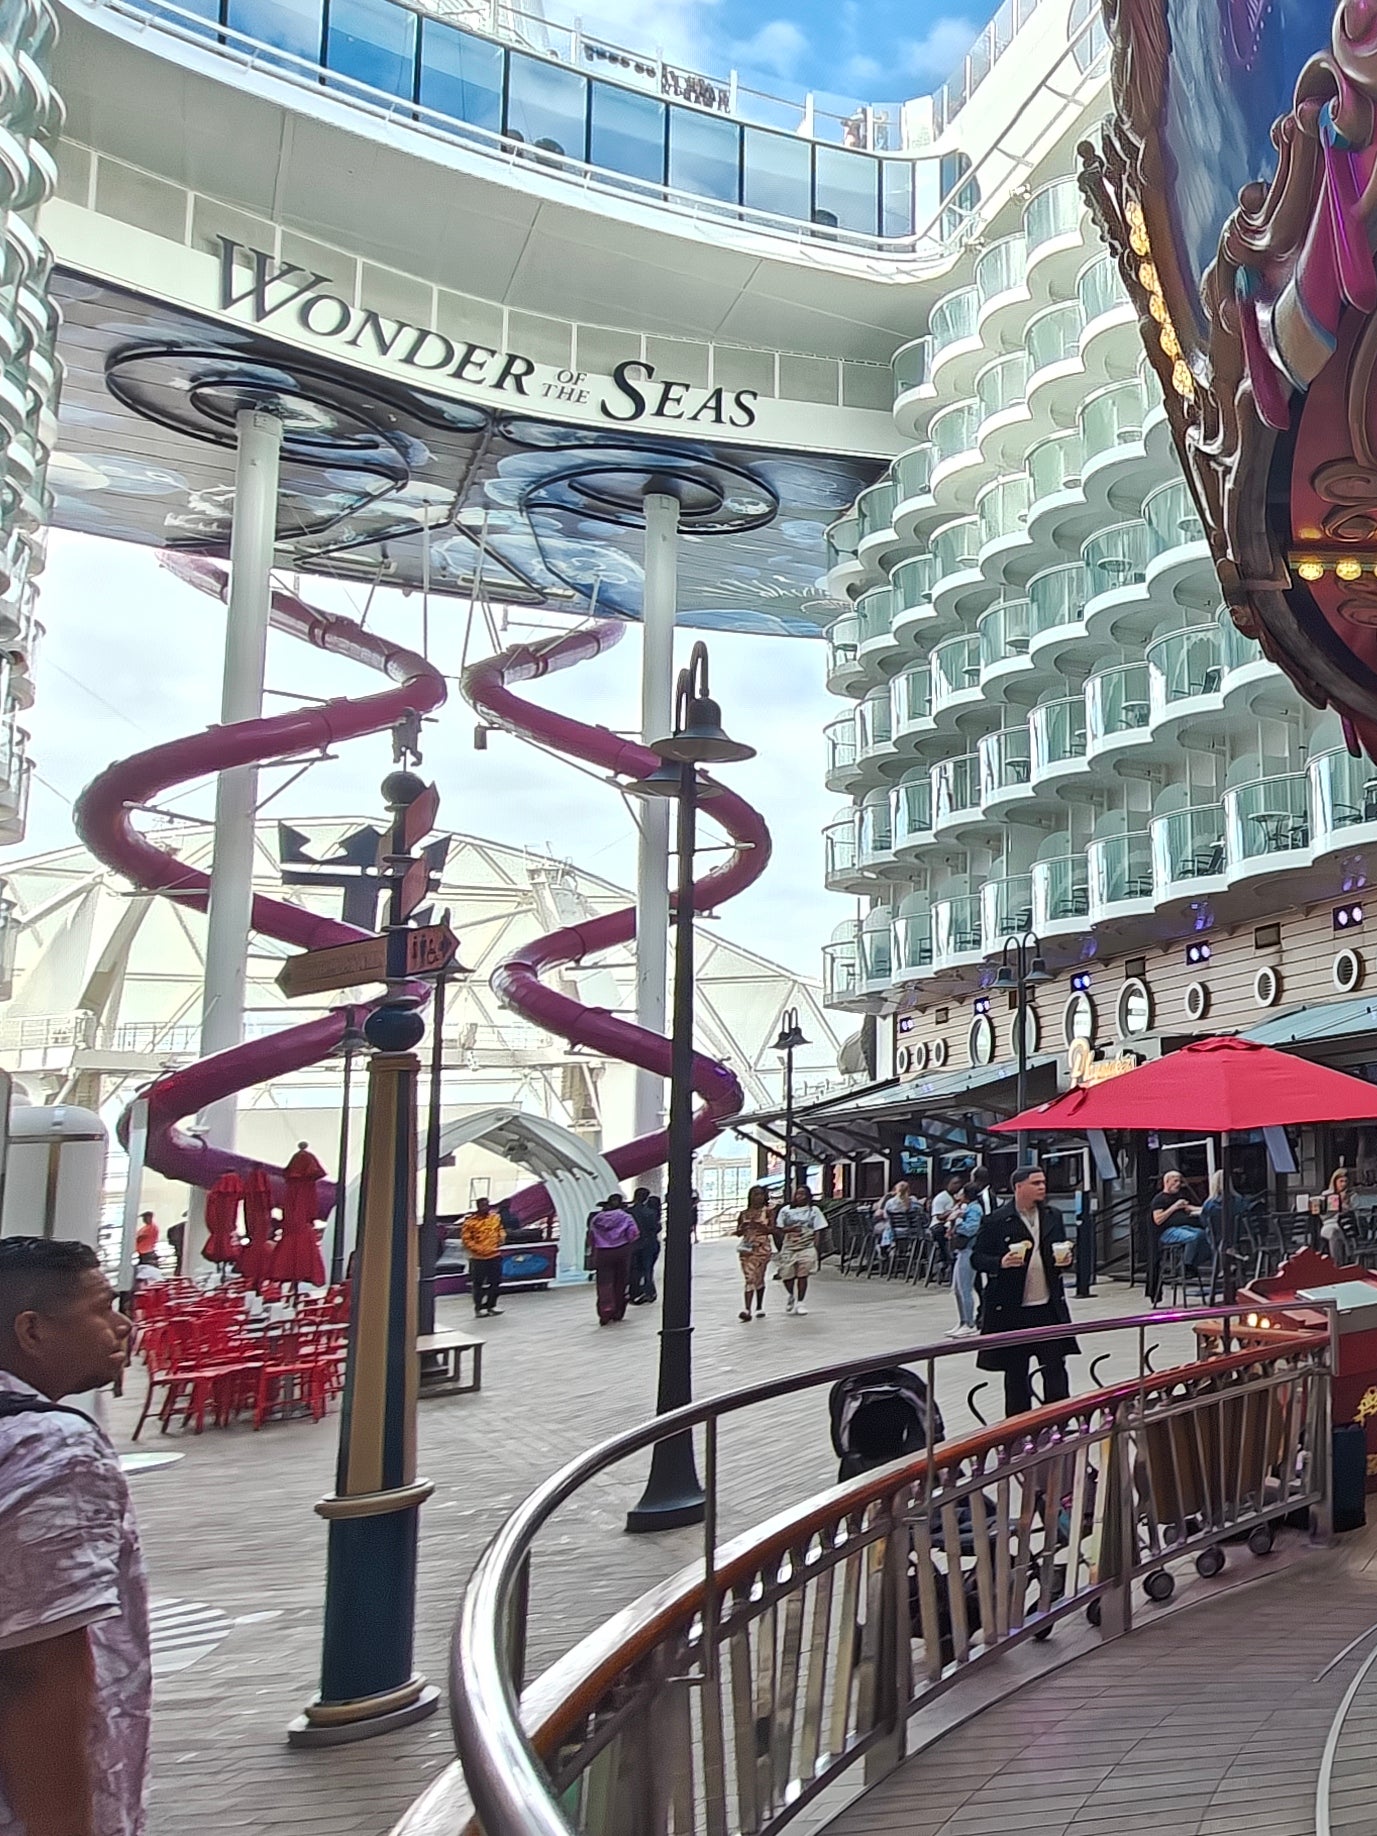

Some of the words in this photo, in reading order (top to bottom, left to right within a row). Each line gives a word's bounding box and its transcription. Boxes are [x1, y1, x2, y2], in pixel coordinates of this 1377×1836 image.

[216, 233, 535, 396] WONDER
[541, 382, 590, 405] THE
[556, 369, 588, 386] OF
[600, 360, 759, 428] SEAS
